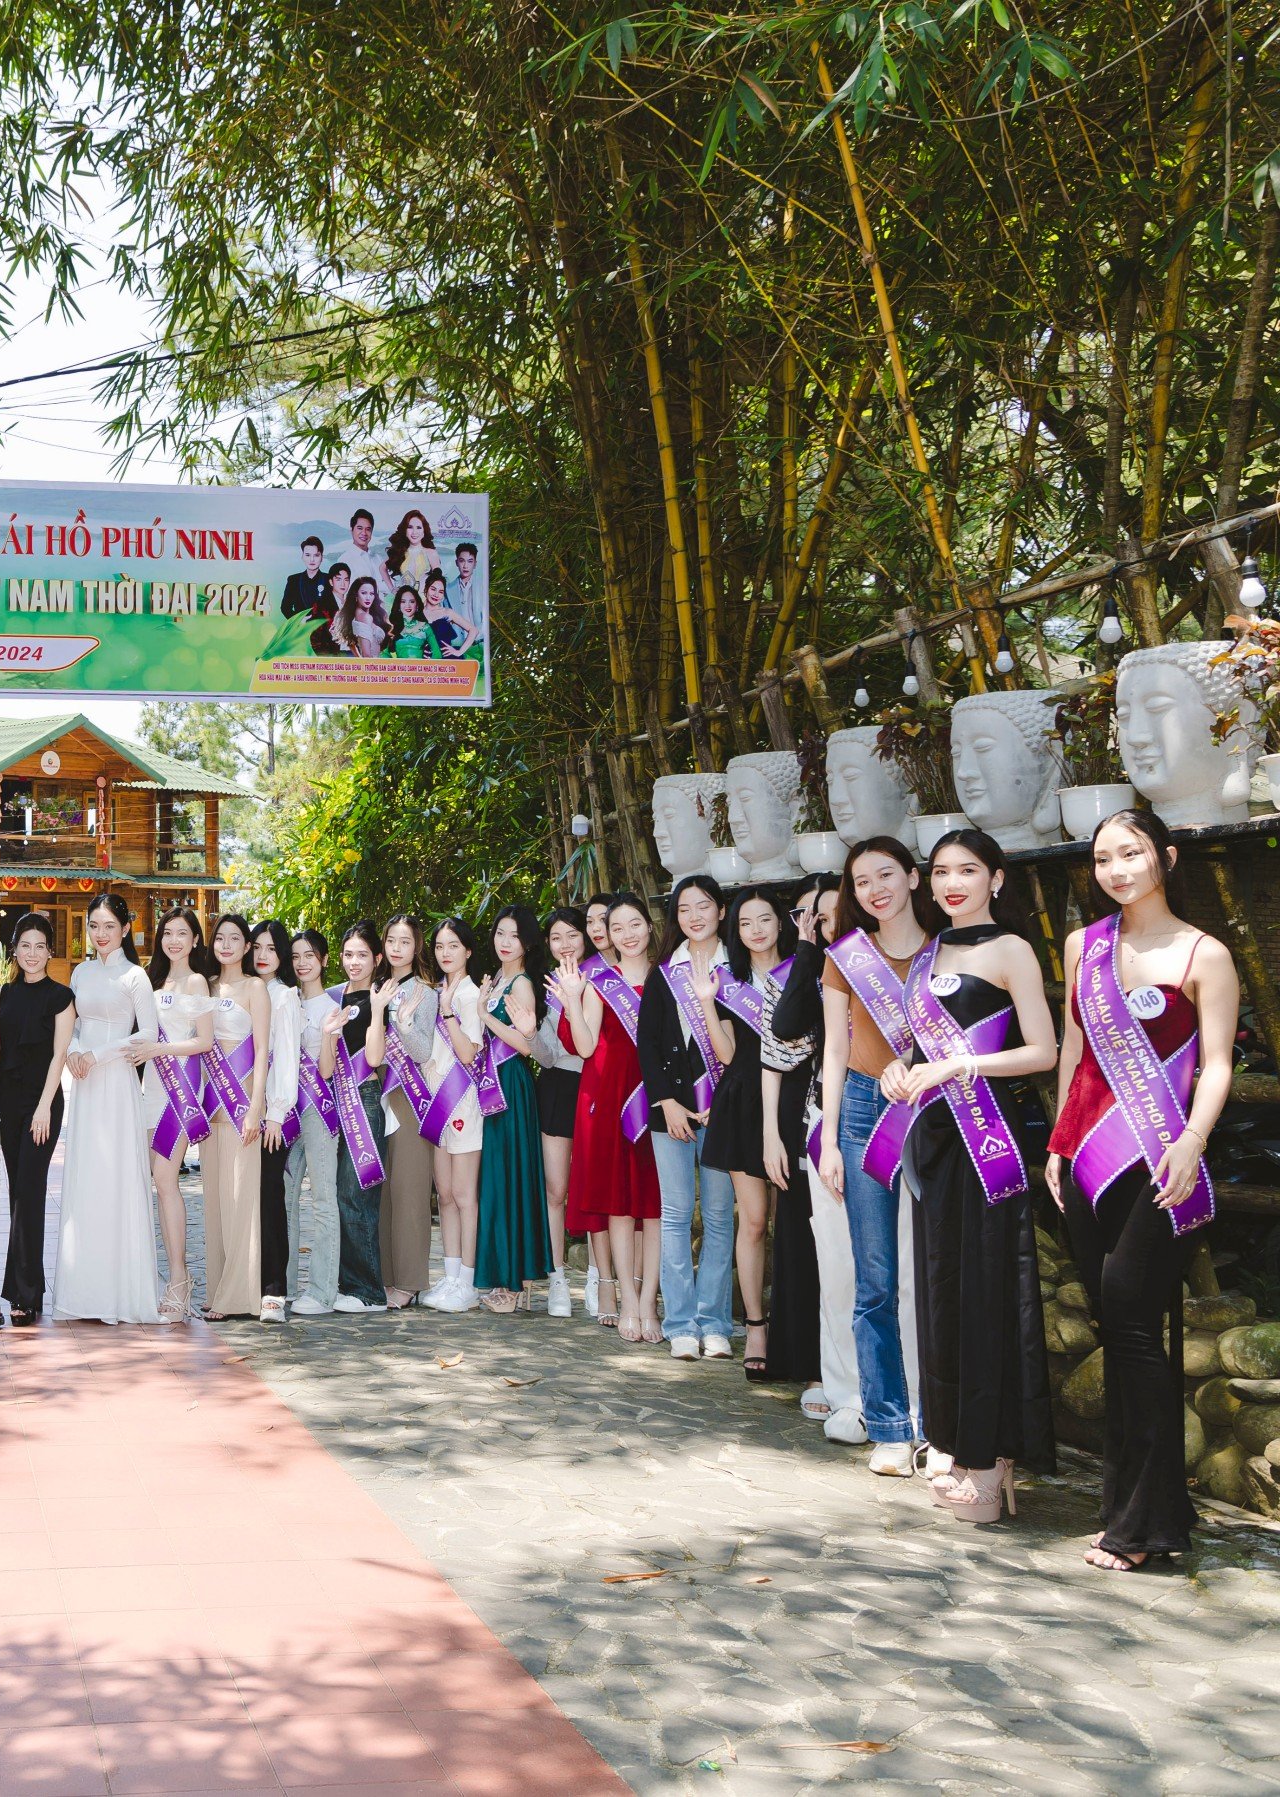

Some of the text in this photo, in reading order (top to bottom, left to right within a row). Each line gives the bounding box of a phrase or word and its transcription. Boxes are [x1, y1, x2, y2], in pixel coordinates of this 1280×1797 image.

[45, 506, 92, 558] HỒ
[101, 516, 167, 560] PHÚ
[175, 528, 255, 561] NINH
[8, 578, 74, 614] NAM
[81, 572, 144, 615] THỜI
[151, 581, 198, 623] ĐẠI
[204, 582, 271, 617] 2024
[682, 982, 696, 1000] HOA
[865, 972, 885, 996] HOA
[881, 995, 903, 1019] HẬU
[933, 977, 958, 989] 037
[161, 995, 173, 1005] 143
[616, 993, 632, 1011] HOA
[741, 996, 760, 1014] HOA
[1131, 990, 1160, 1013] 146
[870, 998, 907, 1051] MISS VIETN
[925, 1018, 949, 1044] VIỆT
[970, 1106, 988, 1131] ĐẠI
[1084, 997, 1150, 1131] MISS VIETNAM ERA 2024
[1091, 965, 1176, 1151] HOA HẬU VIỆT NAM THỜI ĐẠ
[1135, 1048, 1159, 1079] SINH
[167, 1069, 180, 1089] THỜI
[176, 1088, 188, 1104] ĐẠI
[209, 1051, 238, 1103] NAM THỜI ĐẠI
[312, 1082, 324, 1098] ĐẠI
[411, 1082, 422, 1097] ĐẠI
[946, 1082, 963, 1106] 2024
[344, 1094, 354, 1113] NAM
[349, 1113, 360, 1134] THỜI
[355, 1133, 365, 1150] ĐẠI
